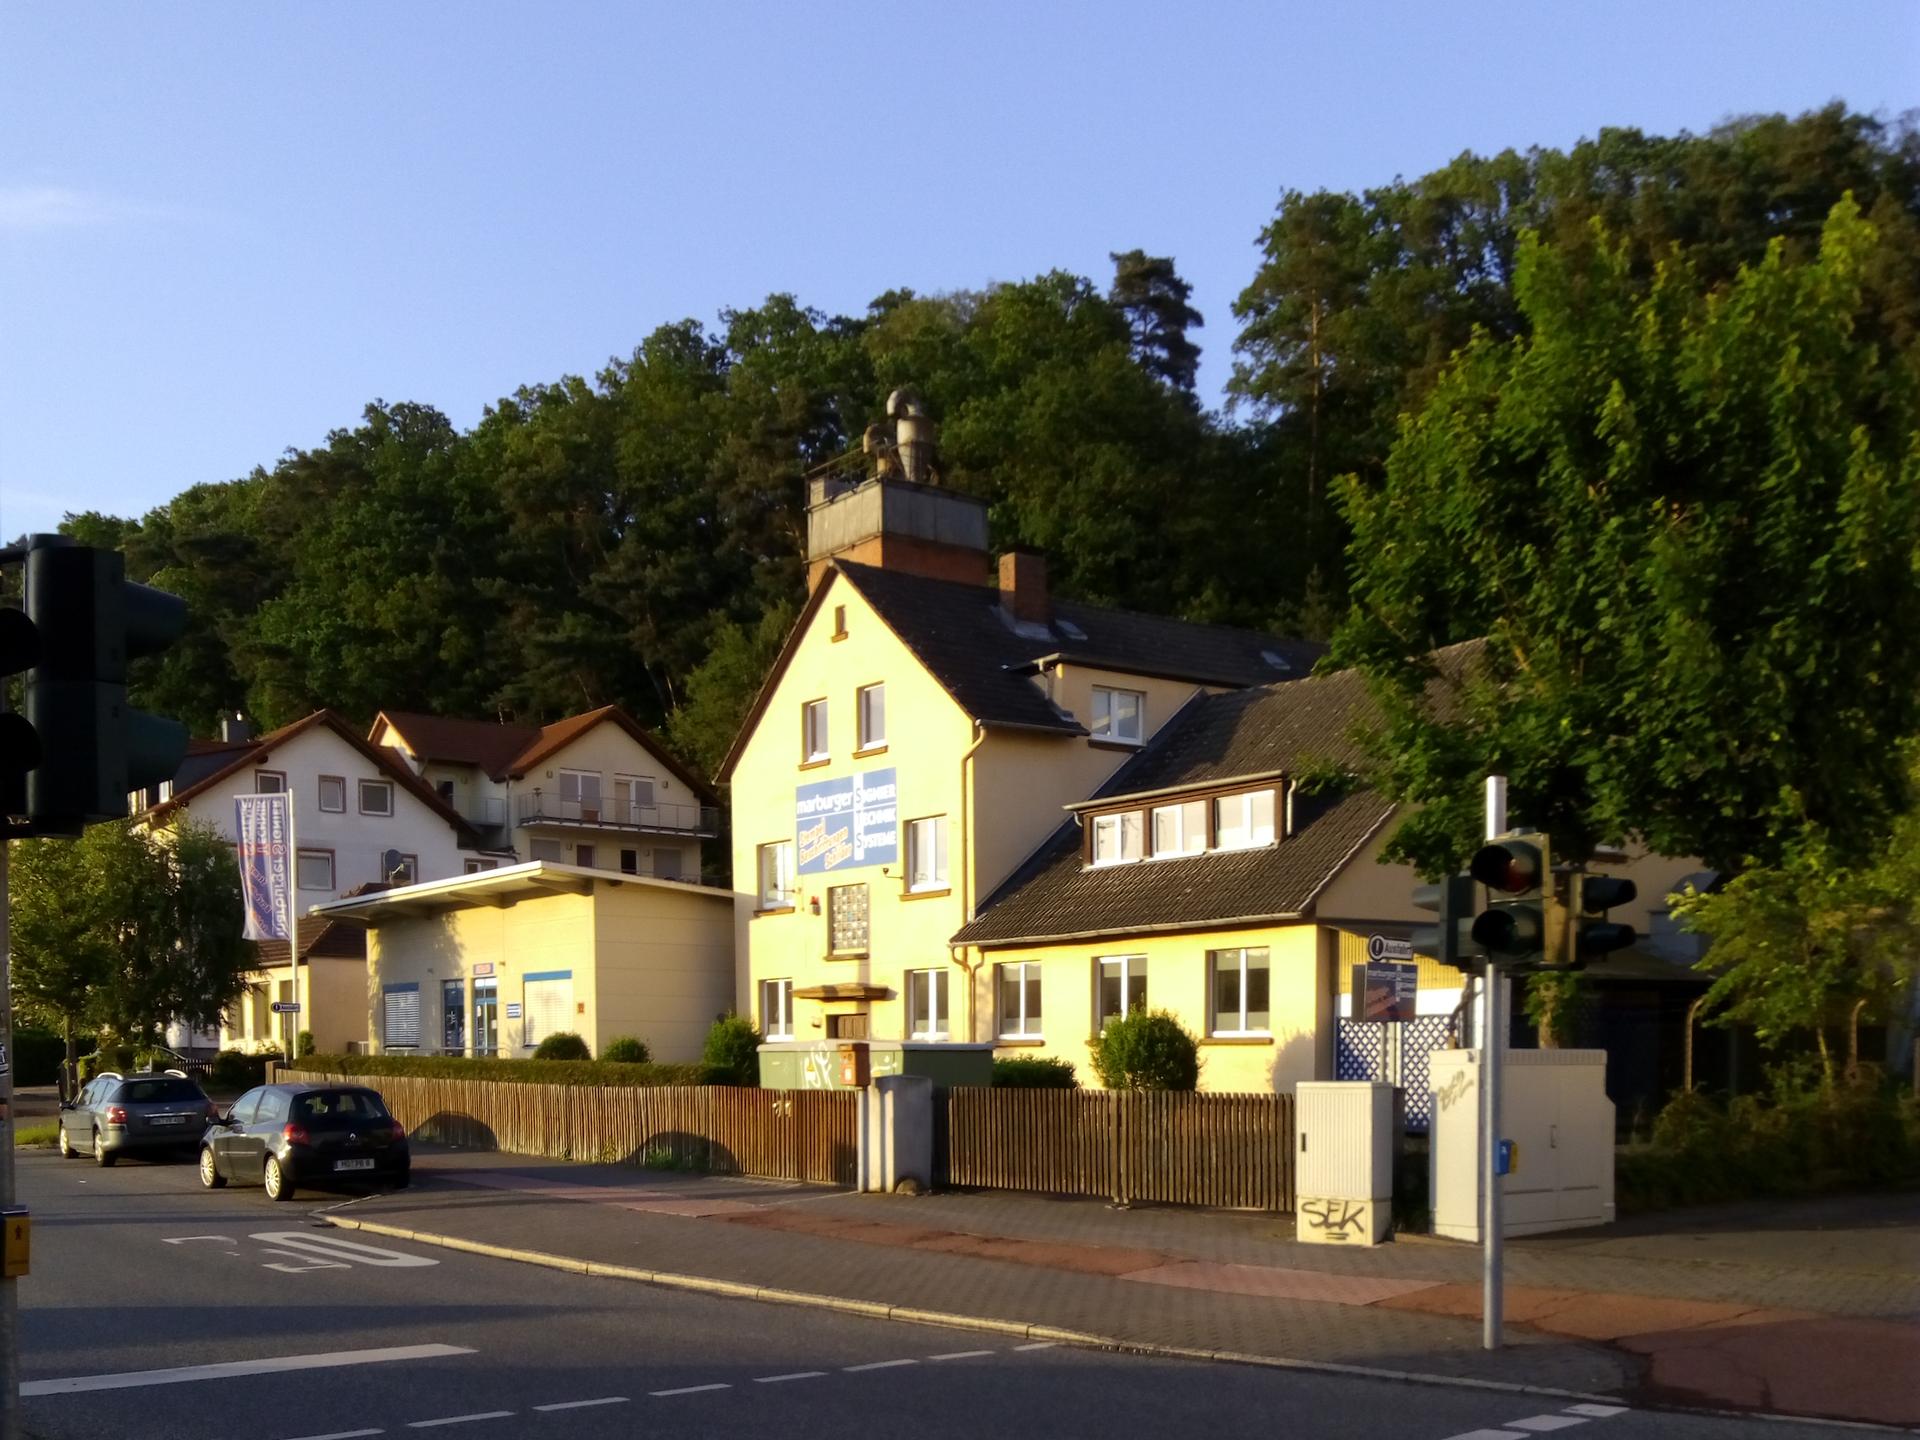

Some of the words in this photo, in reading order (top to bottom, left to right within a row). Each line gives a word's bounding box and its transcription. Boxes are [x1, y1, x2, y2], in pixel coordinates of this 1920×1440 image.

[797, 791, 853, 814] marburger
[855, 783, 896, 804] SIGNIER
[855, 808, 896, 828] TECHNIK
[855, 831, 896, 849] SYSTEME
[1301, 1200, 1365, 1234] SEK
